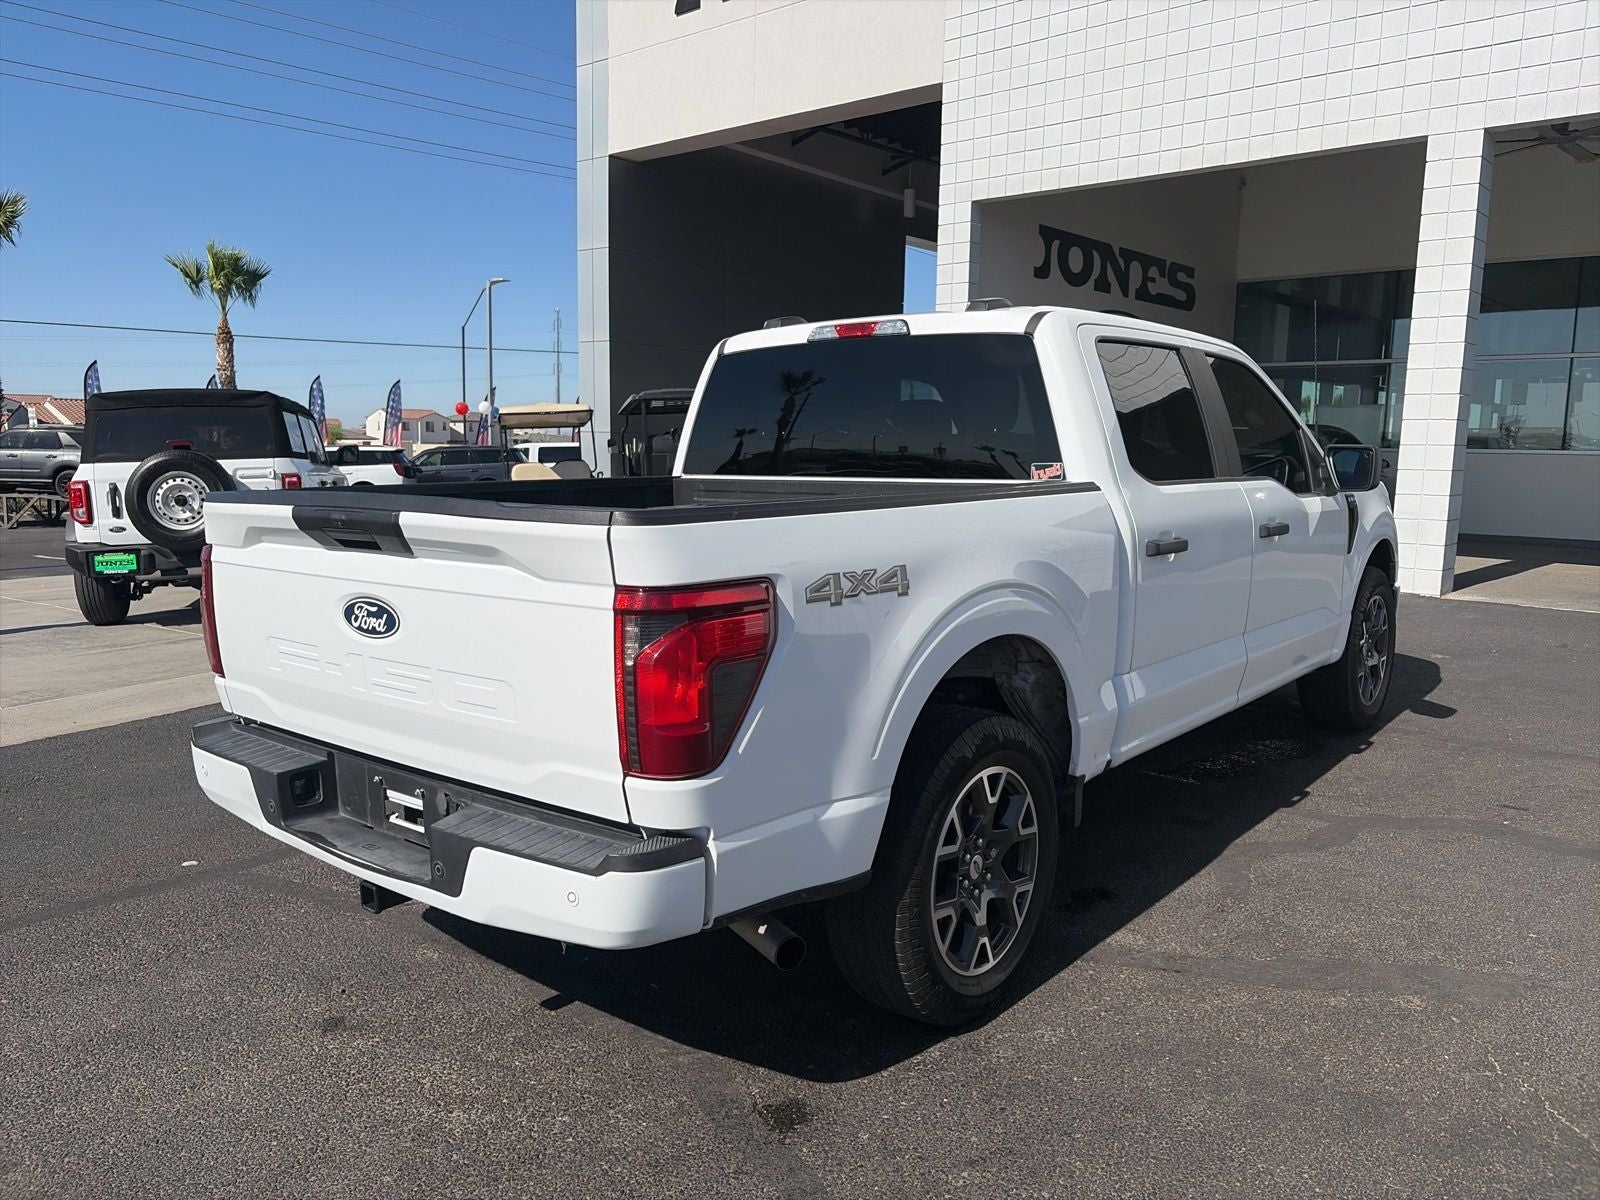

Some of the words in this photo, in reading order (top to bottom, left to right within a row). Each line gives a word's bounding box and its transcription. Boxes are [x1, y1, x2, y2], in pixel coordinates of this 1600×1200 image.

[1033, 223, 1197, 312] JONES
[351, 602, 388, 633] Ford
[265, 635, 518, 723] F-150
